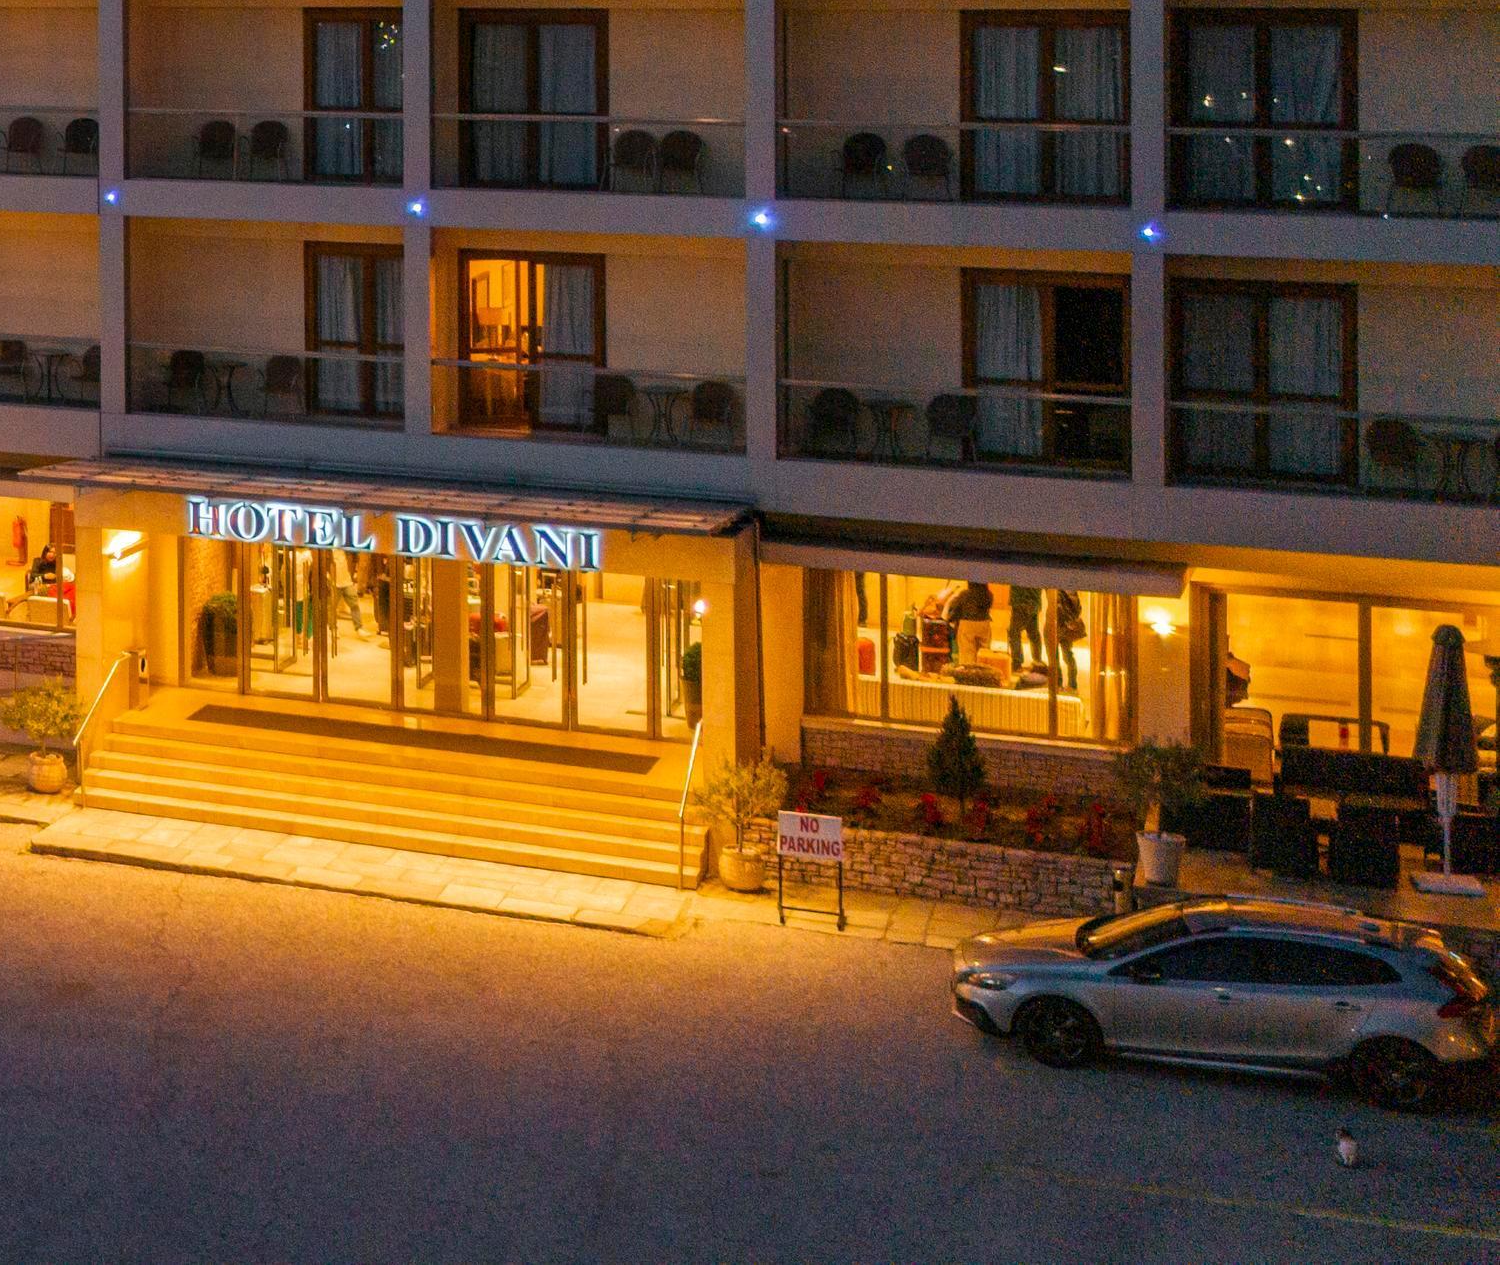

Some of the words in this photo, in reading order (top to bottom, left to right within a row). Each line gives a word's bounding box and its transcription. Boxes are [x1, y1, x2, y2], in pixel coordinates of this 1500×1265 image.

[187, 498, 375, 549] HOTEL
[396, 515, 601, 570] DIVANI
[800, 817, 819, 833] NO
[780, 835, 840, 856] PARKING
